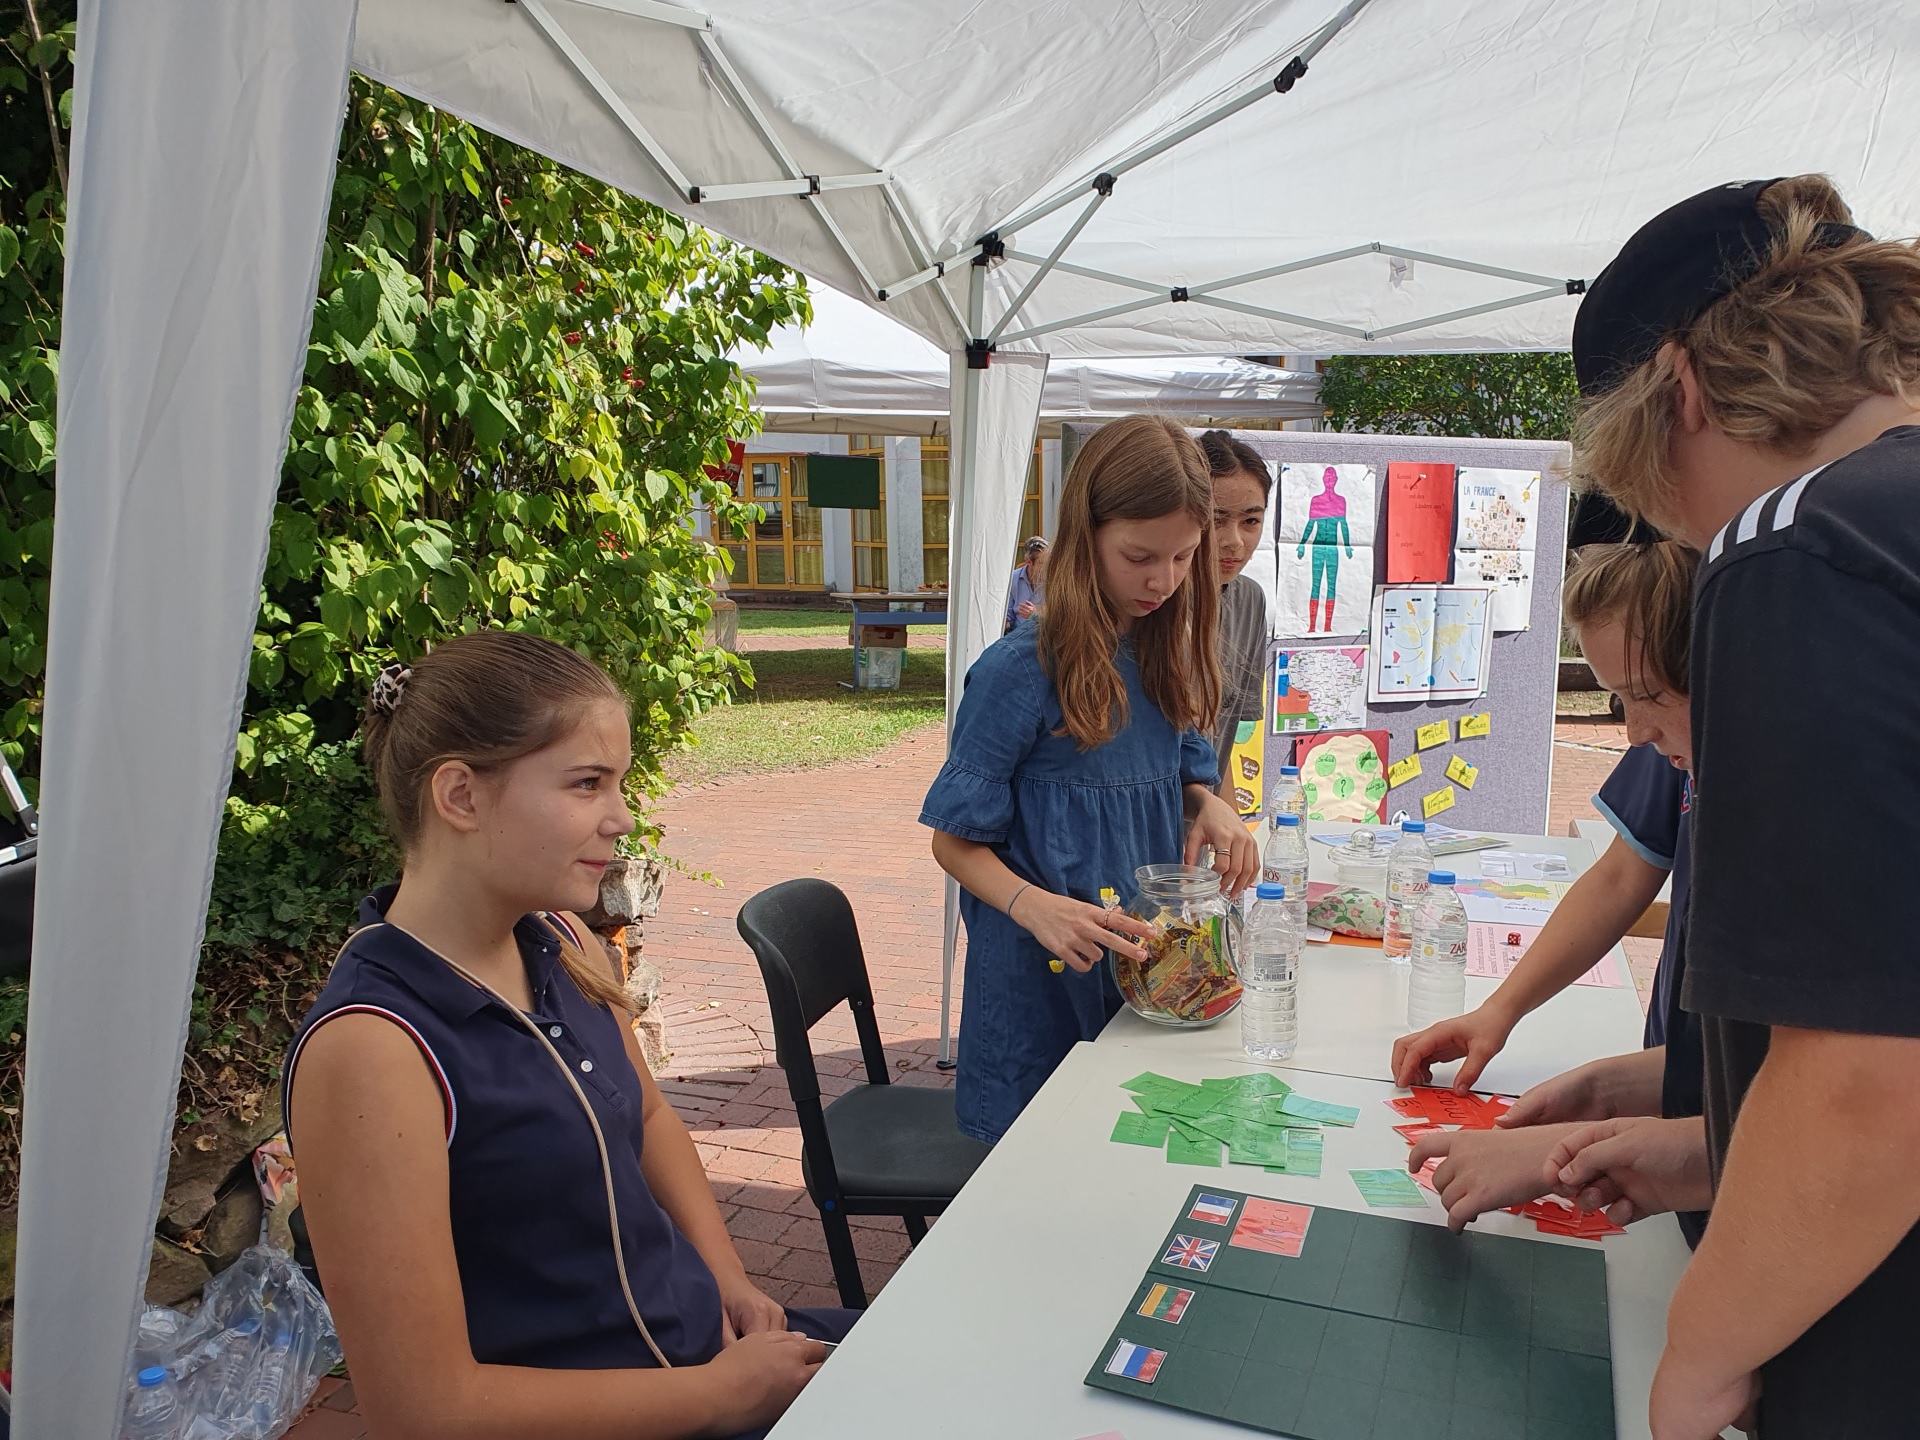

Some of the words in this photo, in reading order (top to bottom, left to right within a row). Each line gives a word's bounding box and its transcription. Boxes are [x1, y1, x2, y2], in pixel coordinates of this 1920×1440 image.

[1463, 485, 1471, 496] LA
[1473, 486, 1497, 496] FRANCE
[1250, 1205, 1291, 1249] Merci
